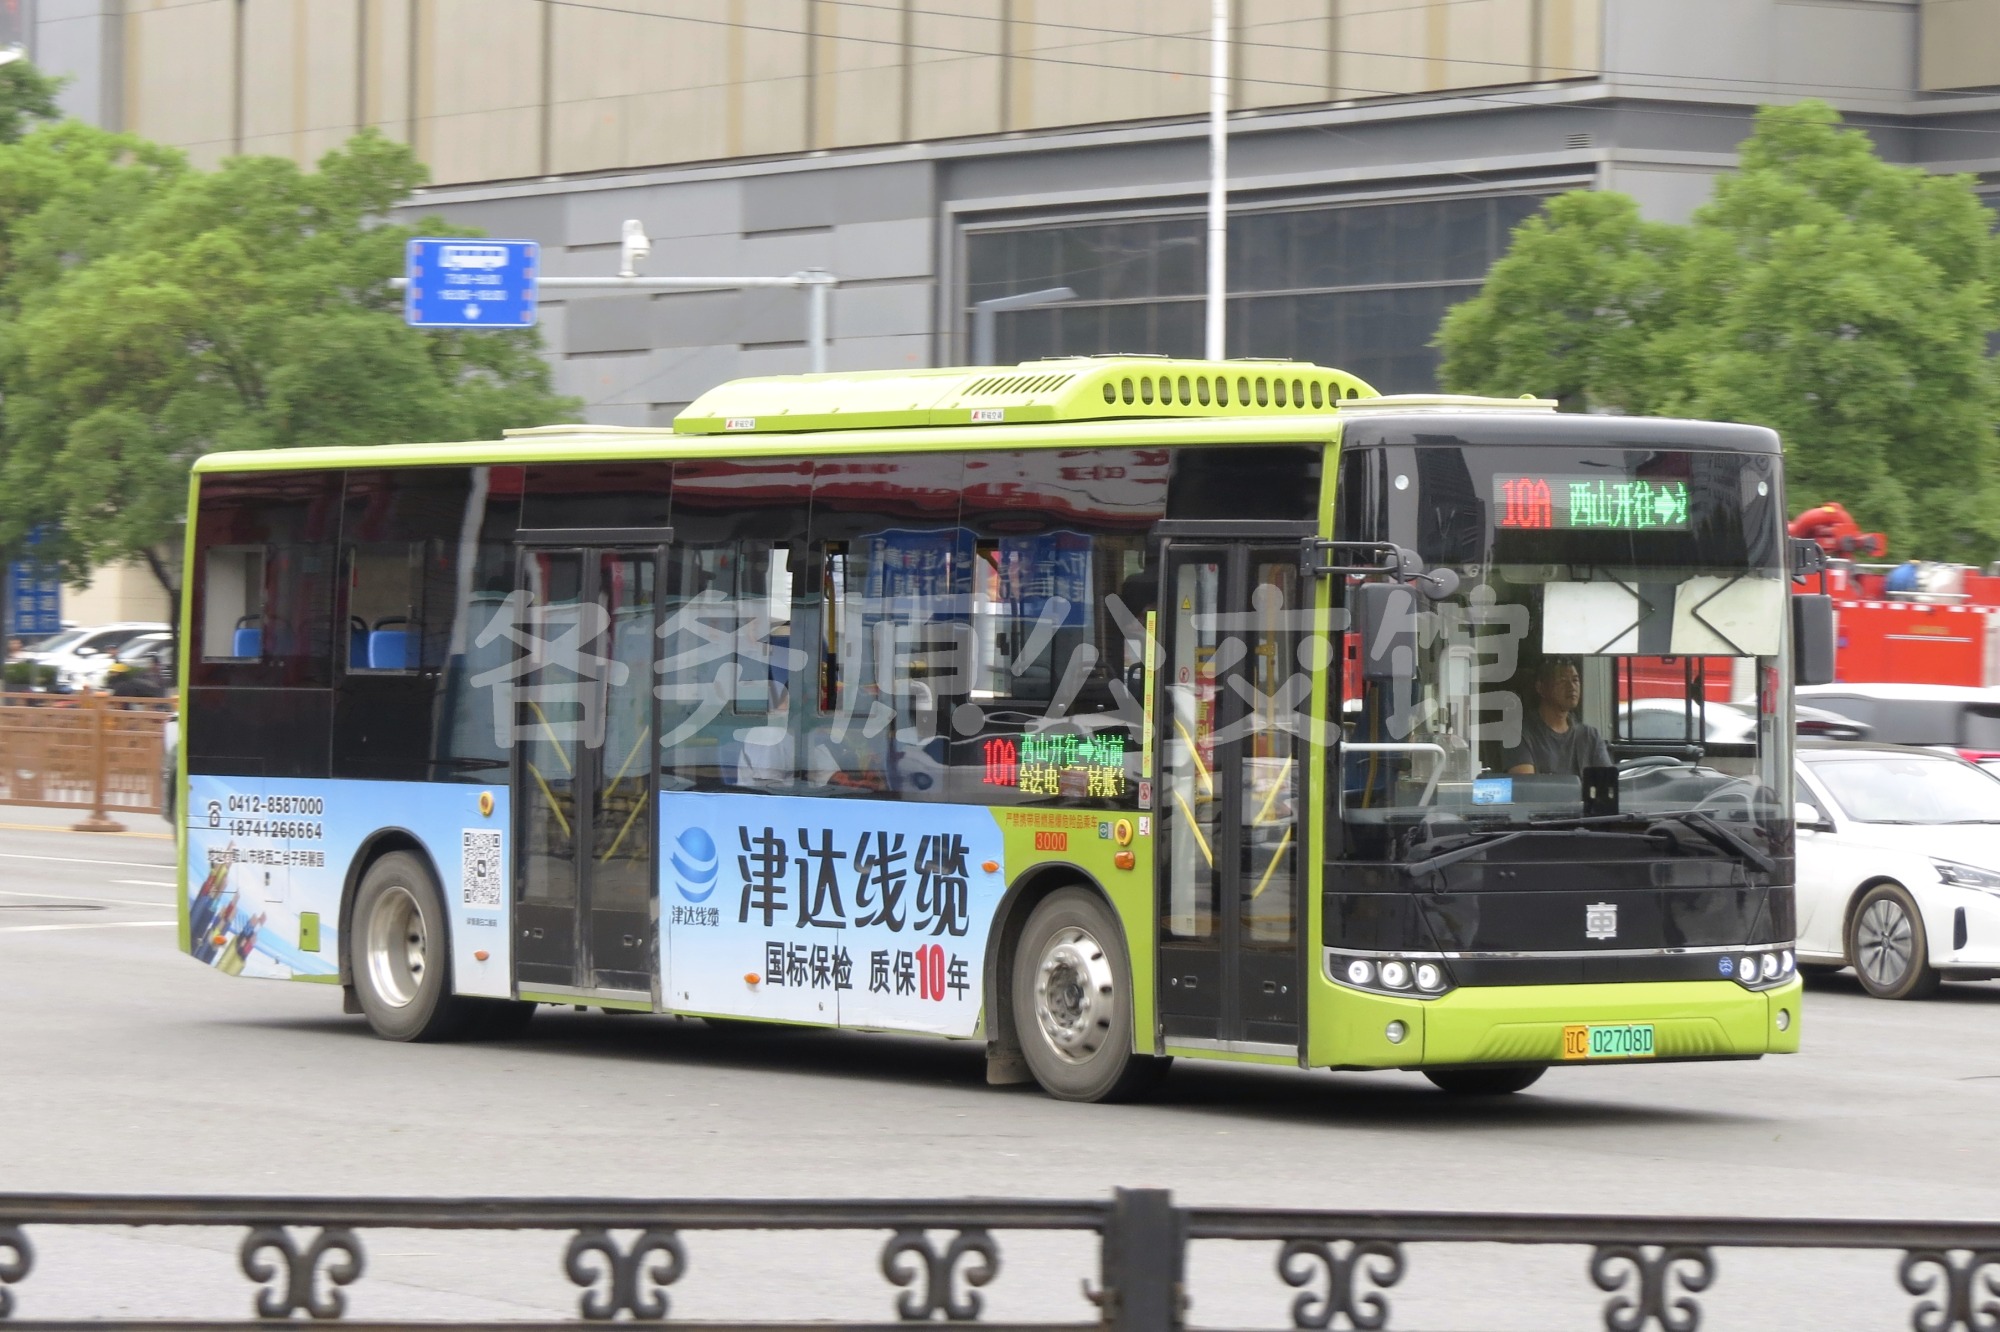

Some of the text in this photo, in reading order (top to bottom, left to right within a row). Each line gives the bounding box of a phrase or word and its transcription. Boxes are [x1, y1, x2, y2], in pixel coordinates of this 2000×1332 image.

[1502, 477, 1552, 529] 10A
[1569, 480, 1656, 528] 西山开往
[983, 738, 1017, 786] 10A
[1020, 732, 1124, 767] 西山开往 站前
[228, 795, 323, 815] 0412-8587000
[228, 820, 322, 839] 18741266664
[1036, 832, 1066, 850] 3000
[737, 825, 970, 936] 津达线缆
[671, 905, 720, 927] 津达线缆
[765, 940, 970, 1002] 国标保检 质保10年
[1566, 1028, 1653, 1054] 辽C 02708D
